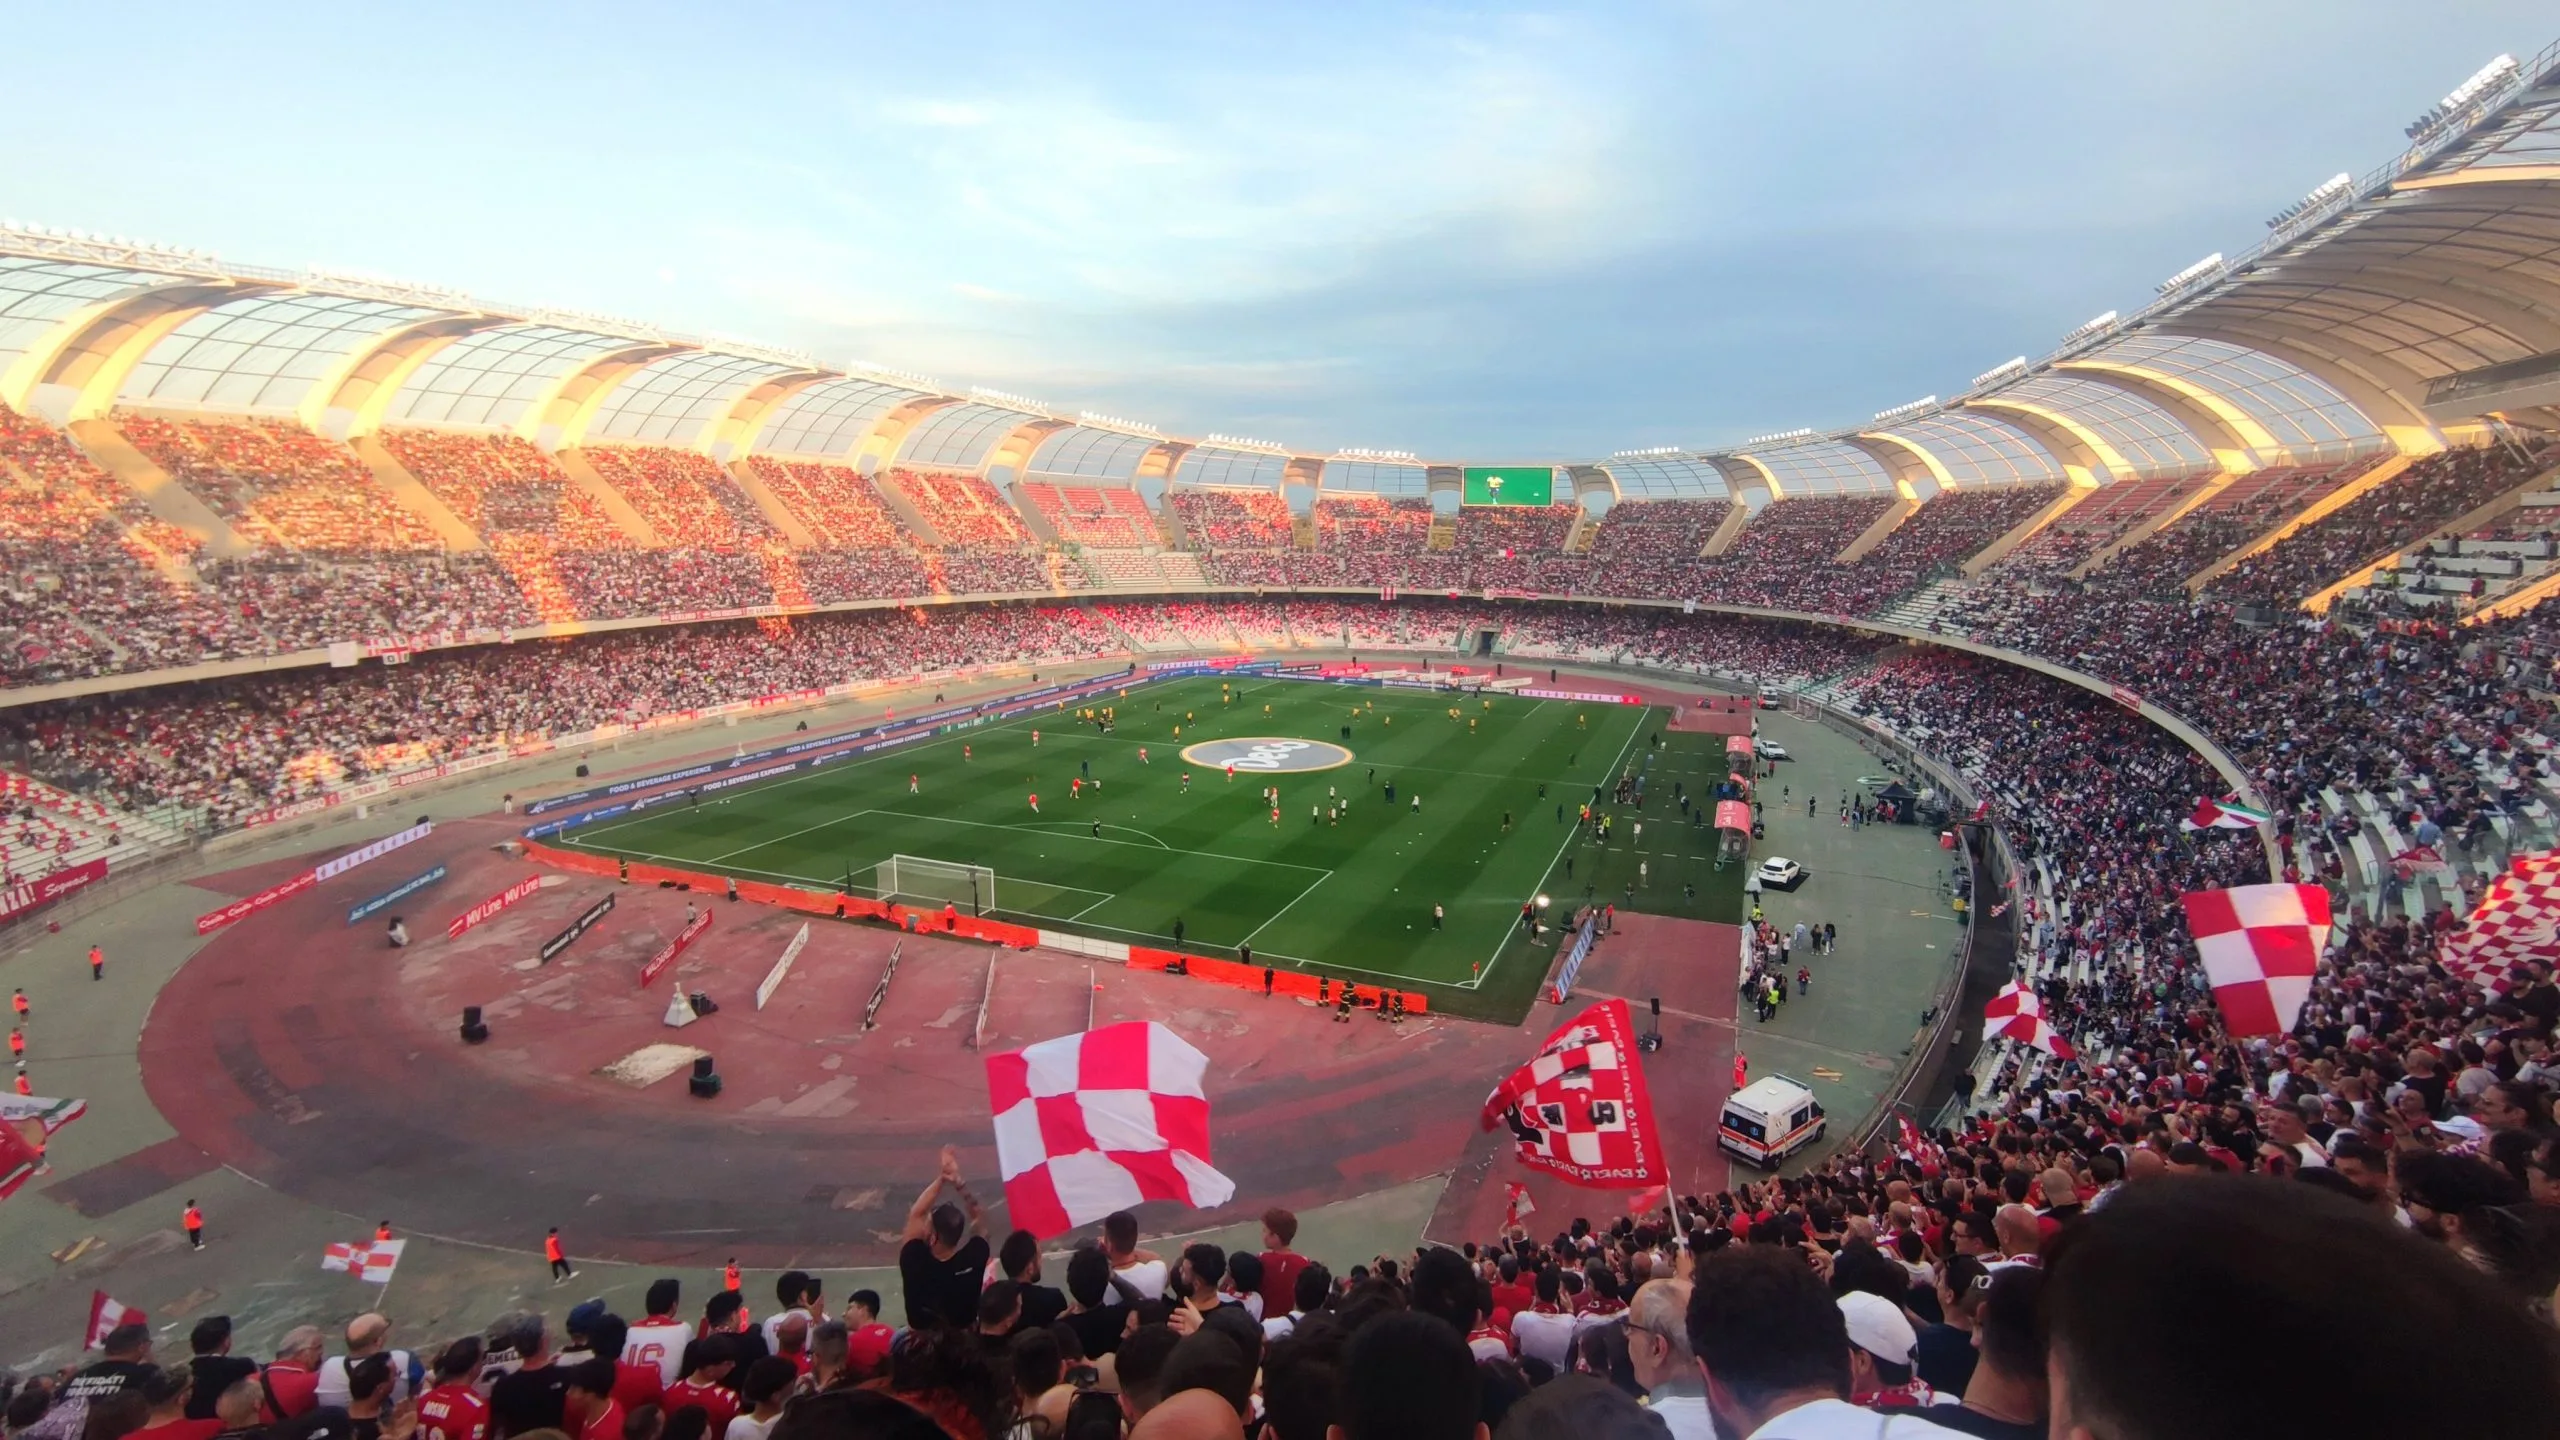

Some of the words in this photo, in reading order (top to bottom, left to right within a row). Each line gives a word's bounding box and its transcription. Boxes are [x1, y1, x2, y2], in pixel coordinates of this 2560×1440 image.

[609, 782, 629, 794] FOOD
[636, 774, 671, 788] BEVERAGE
[672, 765, 712, 779] EXPERIENCE
[703, 781, 722, 792] FOOD
[728, 772, 759, 785] BEVERAGE
[760, 764, 796, 778] EXPERIENCE
[273, 797, 326, 821] CAPURSO
[466, 907, 482, 928] MV
[482, 898, 502, 918] Line
[504, 885, 519, 906] MV
[520, 878, 539, 896] Line
